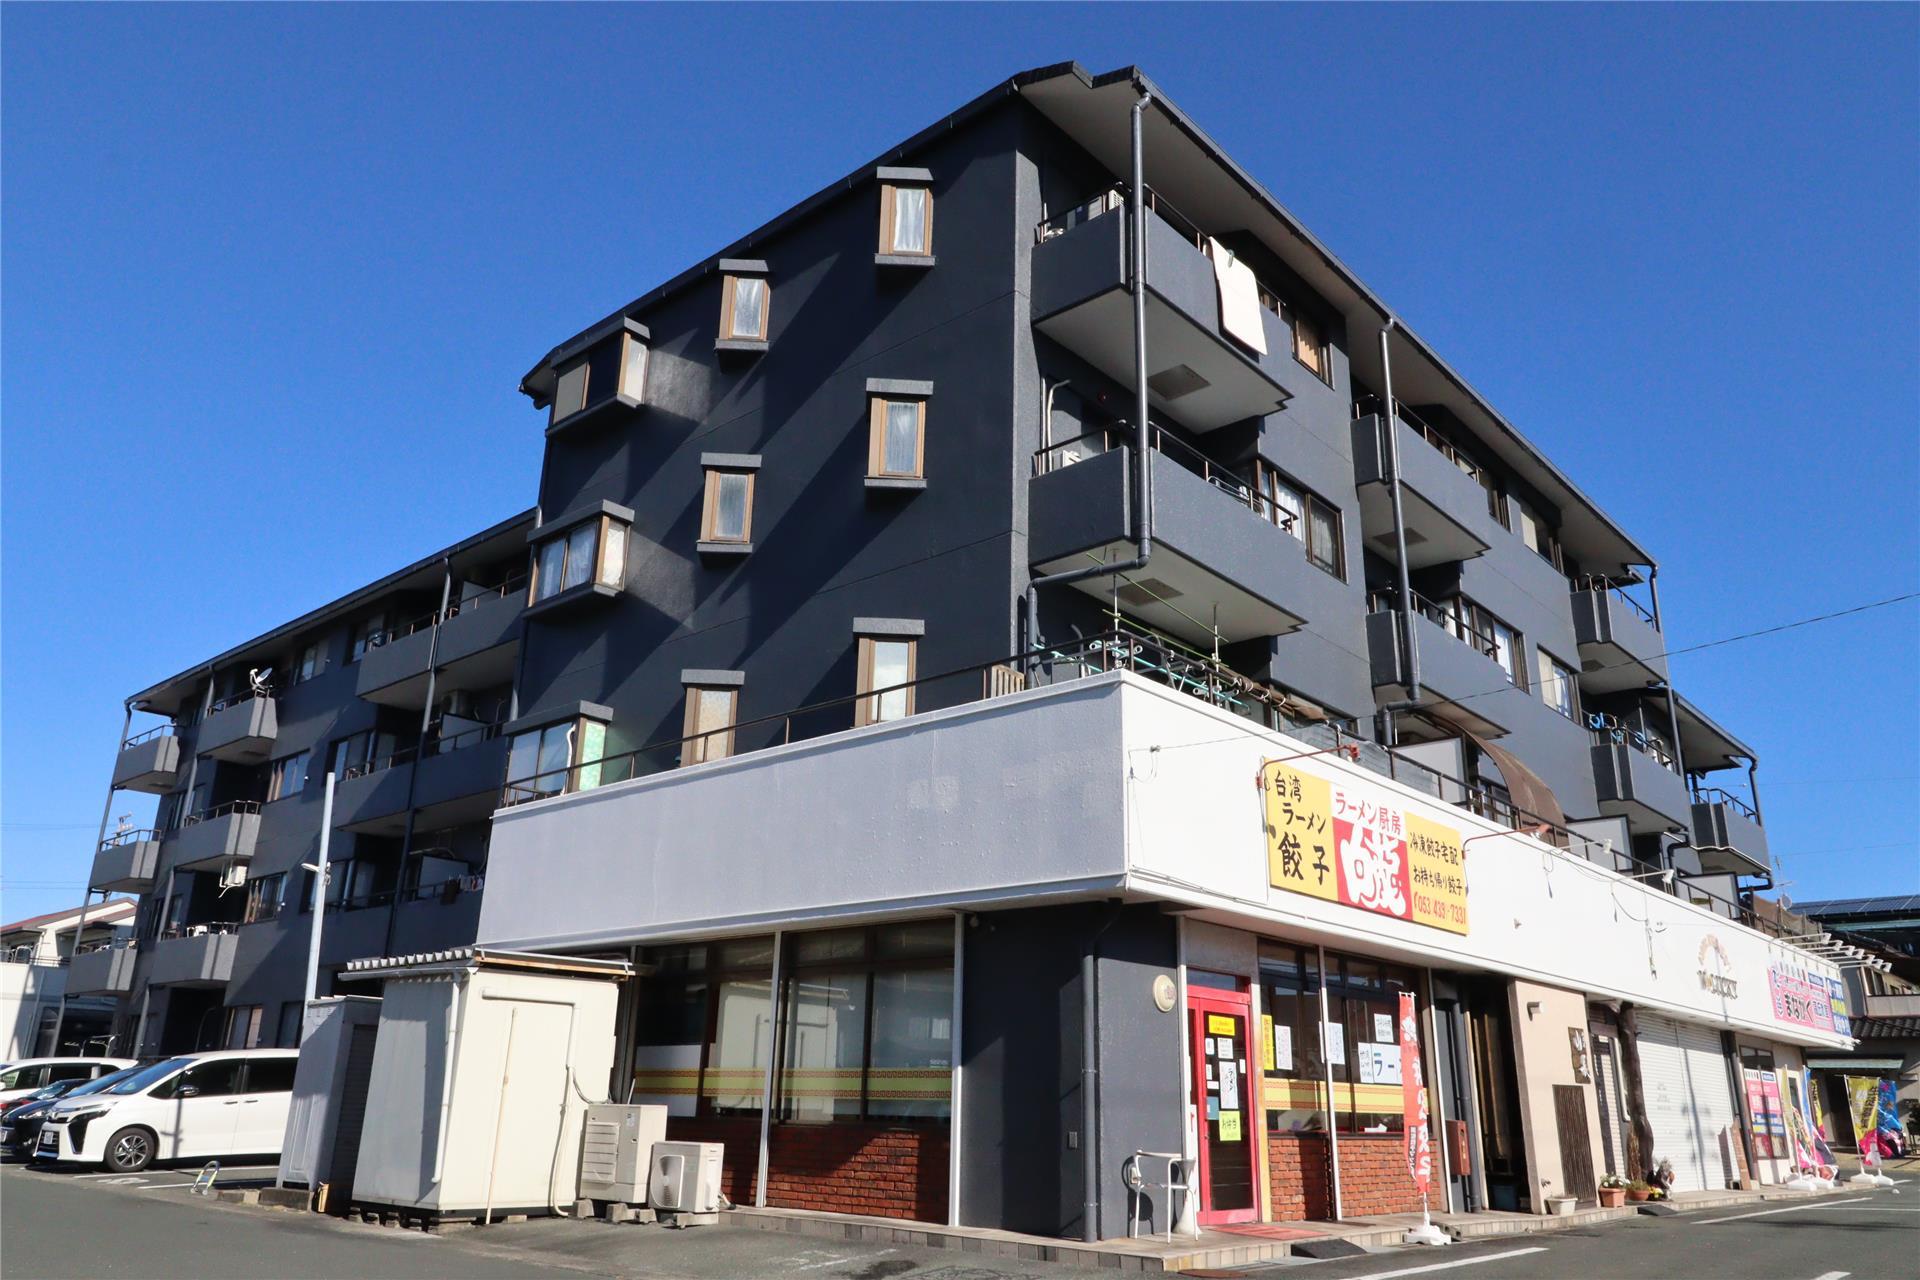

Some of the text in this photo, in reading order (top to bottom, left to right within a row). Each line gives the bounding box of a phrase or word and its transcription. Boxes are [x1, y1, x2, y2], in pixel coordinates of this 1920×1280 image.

[1275, 770, 1301, 802] 台湾
[1282, 802, 1326, 834] ラーメン
[1336, 792, 1401, 836] ラーメン厨房
[1278, 831, 1330, 885] 餃子
[1410, 832, 1459, 866] 冷凍餃子宅配
[1413, 865, 1463, 896] お持ち帰り餃子
